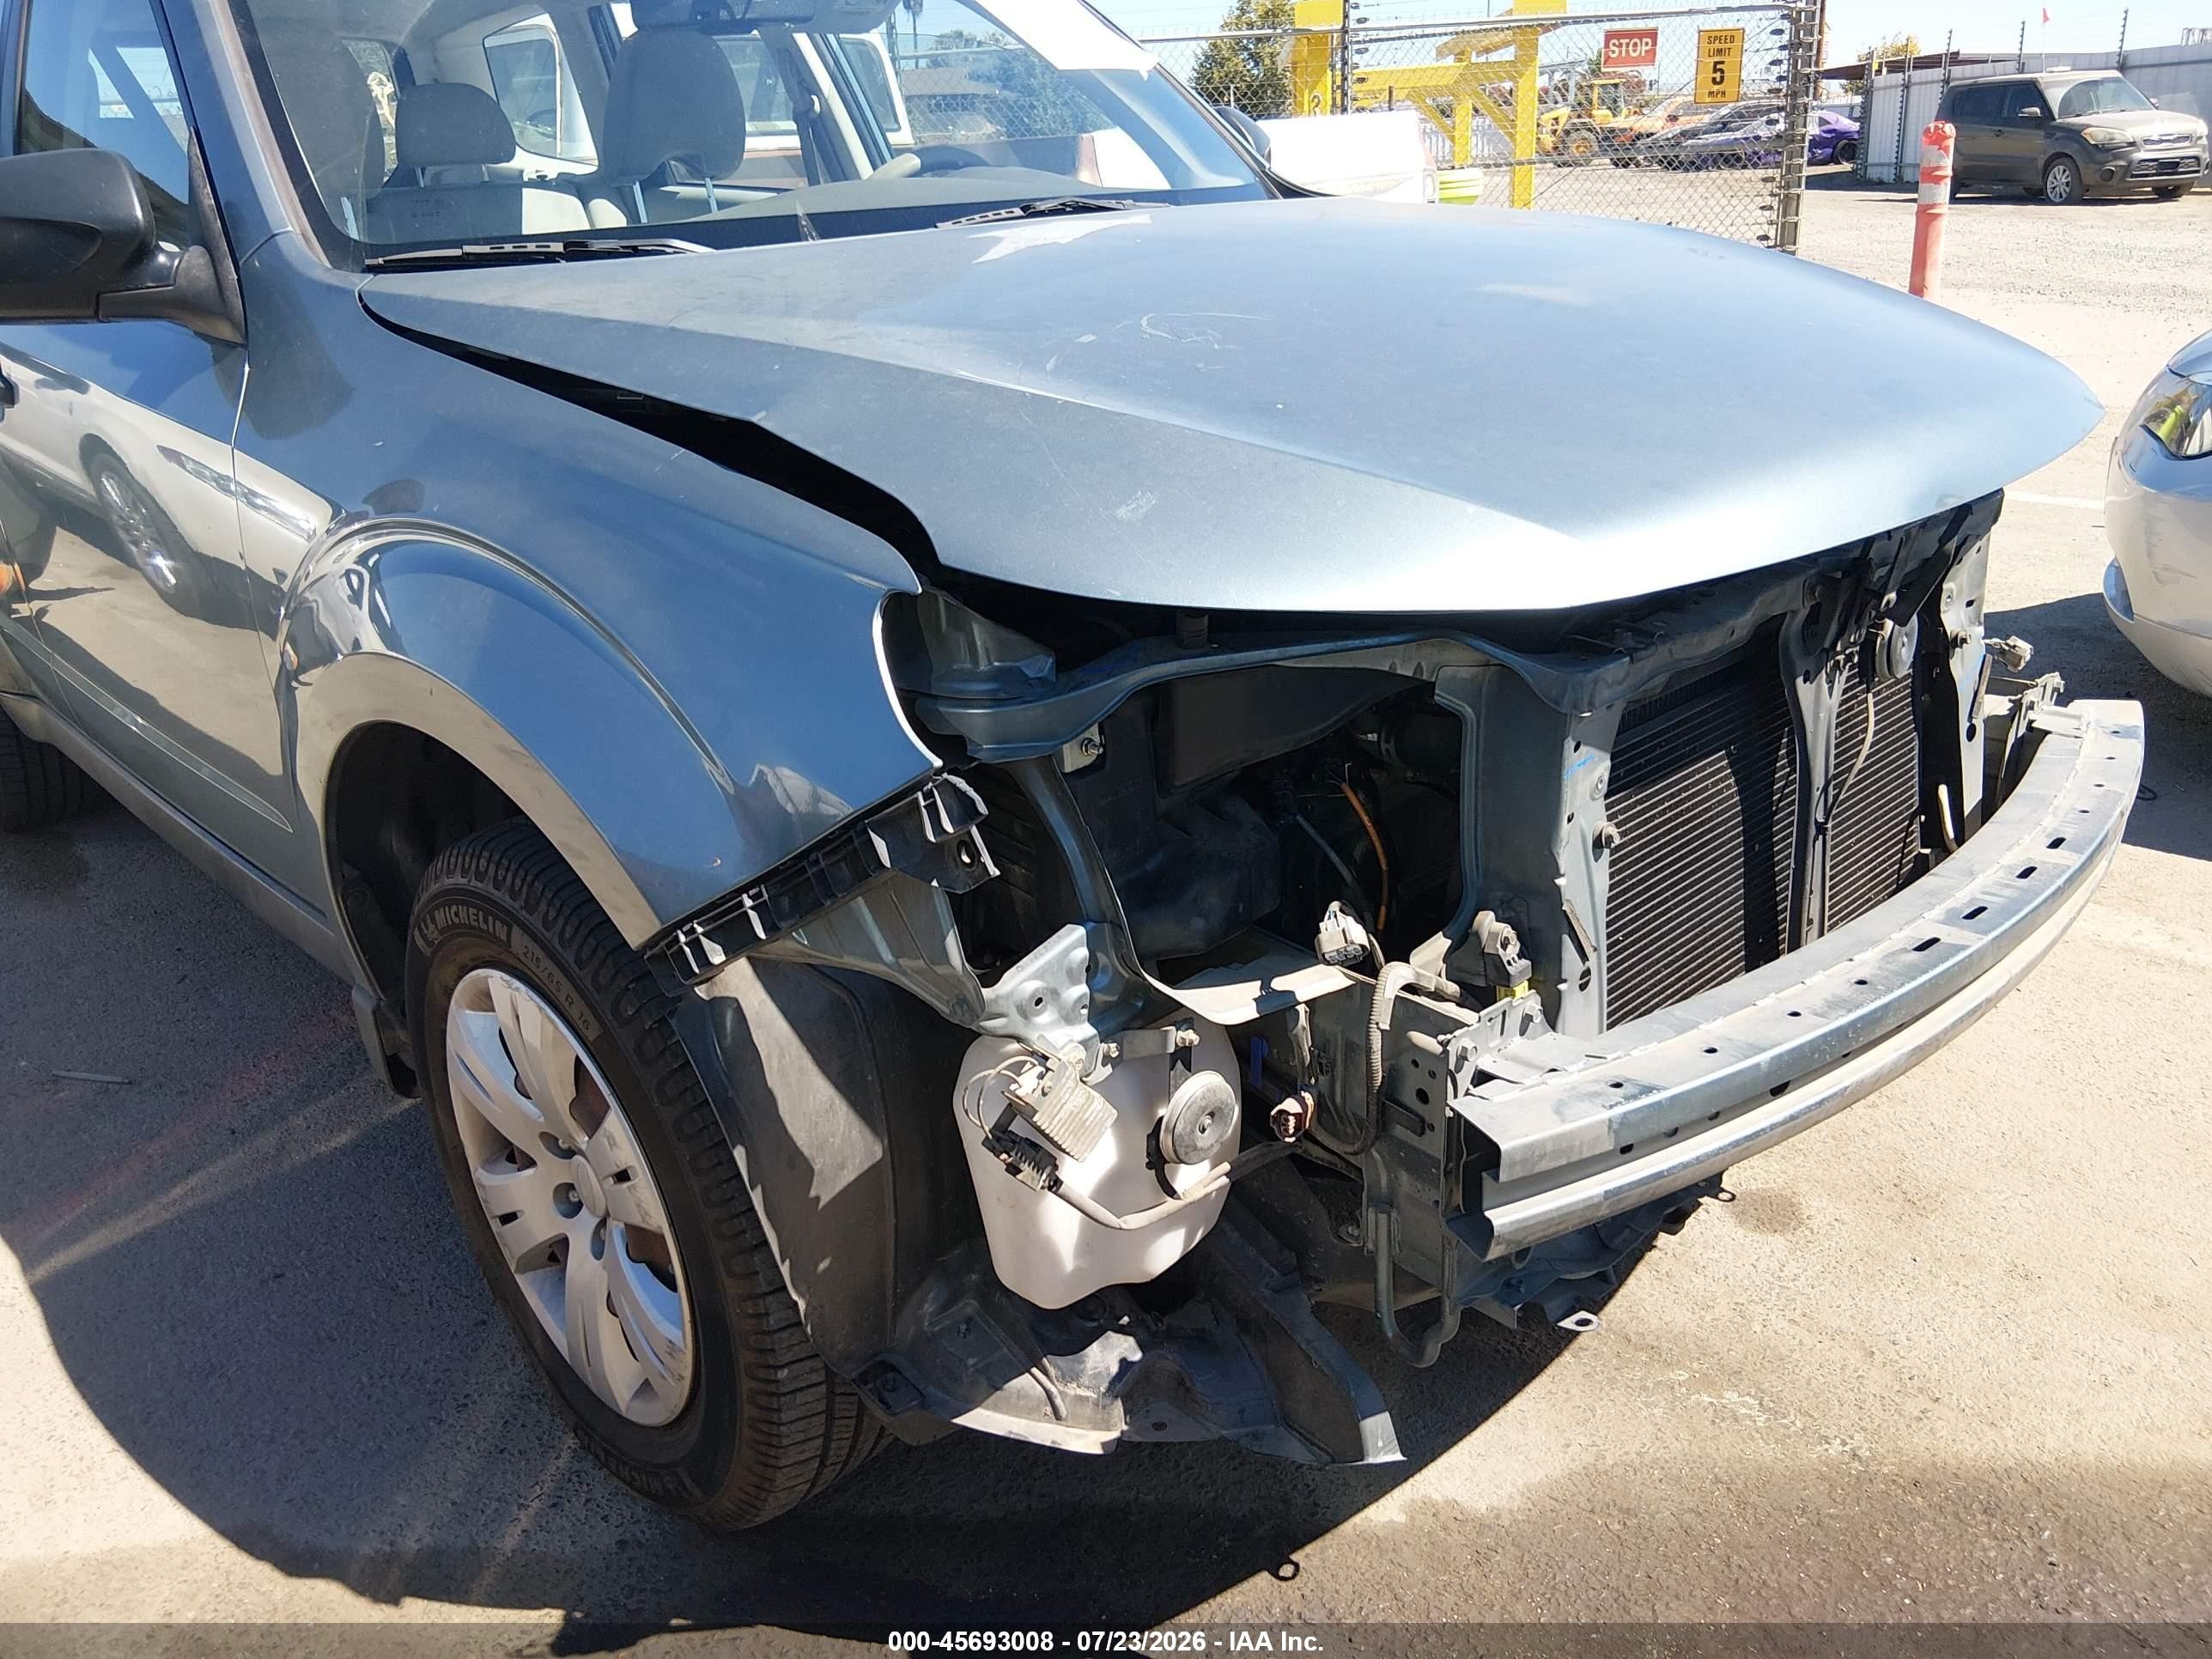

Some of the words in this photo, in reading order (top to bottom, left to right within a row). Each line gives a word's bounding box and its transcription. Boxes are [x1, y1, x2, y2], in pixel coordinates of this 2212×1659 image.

[1608, 38, 1652, 58] STOP
[1707, 34, 1735, 45] SPEED
[1707, 47, 1733, 58] LIMIT
[1711, 60, 1725, 86] 5
[434, 904, 508, 942] MICHELIN
